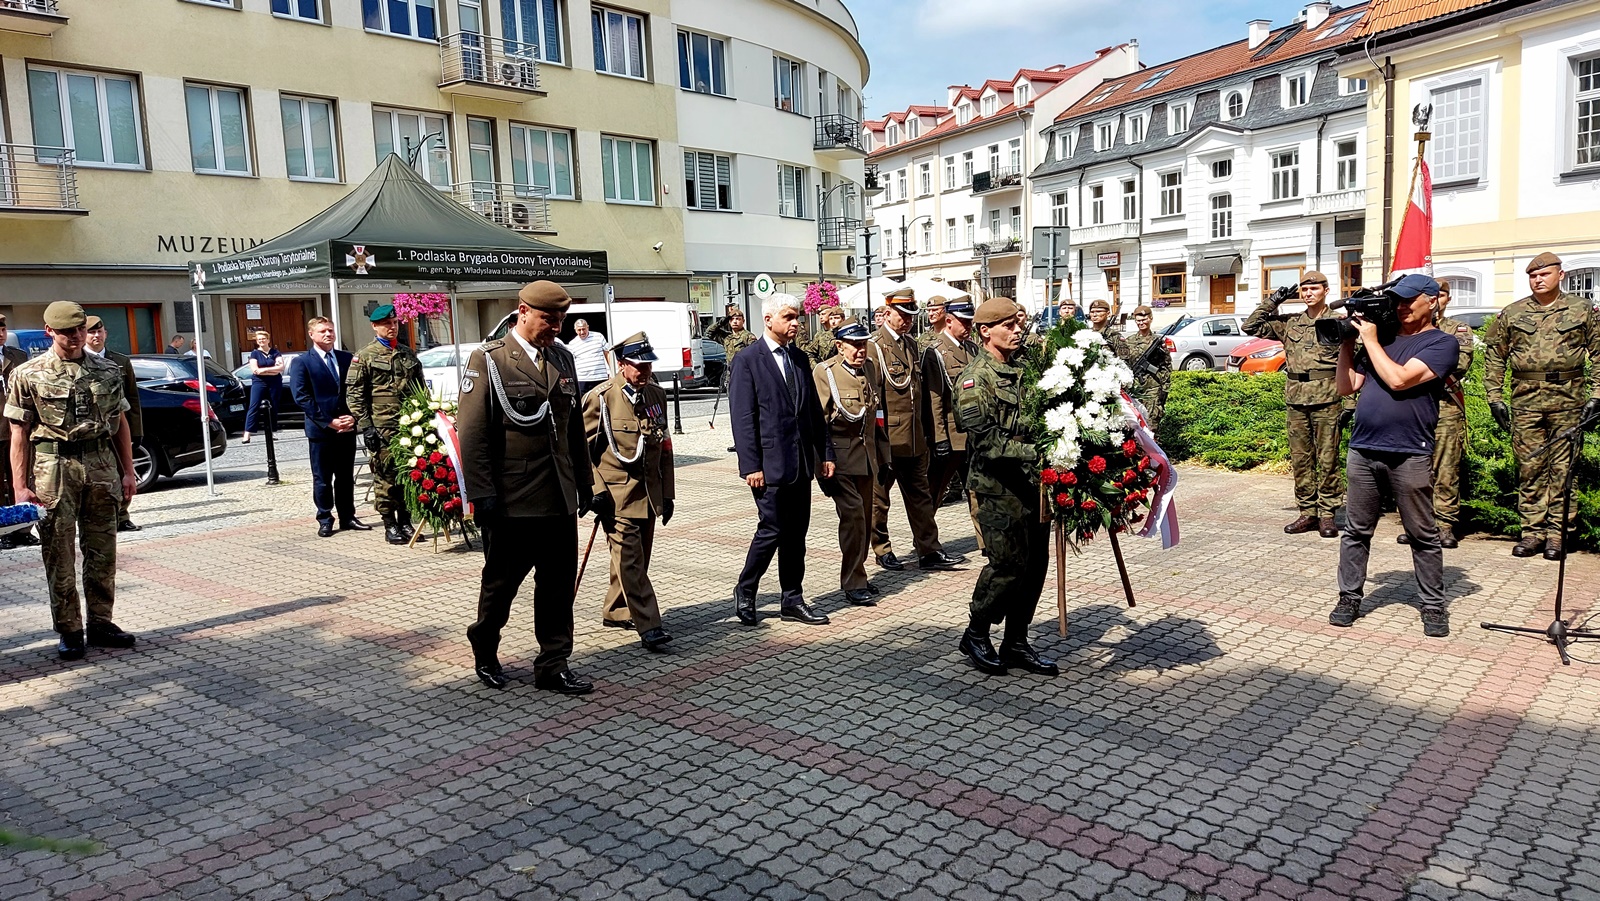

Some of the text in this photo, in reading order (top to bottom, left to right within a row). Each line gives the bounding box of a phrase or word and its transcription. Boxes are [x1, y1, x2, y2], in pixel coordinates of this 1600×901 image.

[217, 260, 240, 273] Podlaska
[238, 256, 260, 271] Brygada
[259, 254, 280, 267] Obrony
[279, 247, 317, 264] Terytorialnej
[396, 249, 591, 269] 1. Podlaska Brygada Obrony Terytorialnej
[417, 265, 429, 273] im.
[430, 266, 445, 275] gen.
[446, 266, 462, 275] bryg.
[463, 266, 500, 276] Władysława
[501, 267, 536, 277] Liniarskiego
[537, 269, 546, 277] ps.
